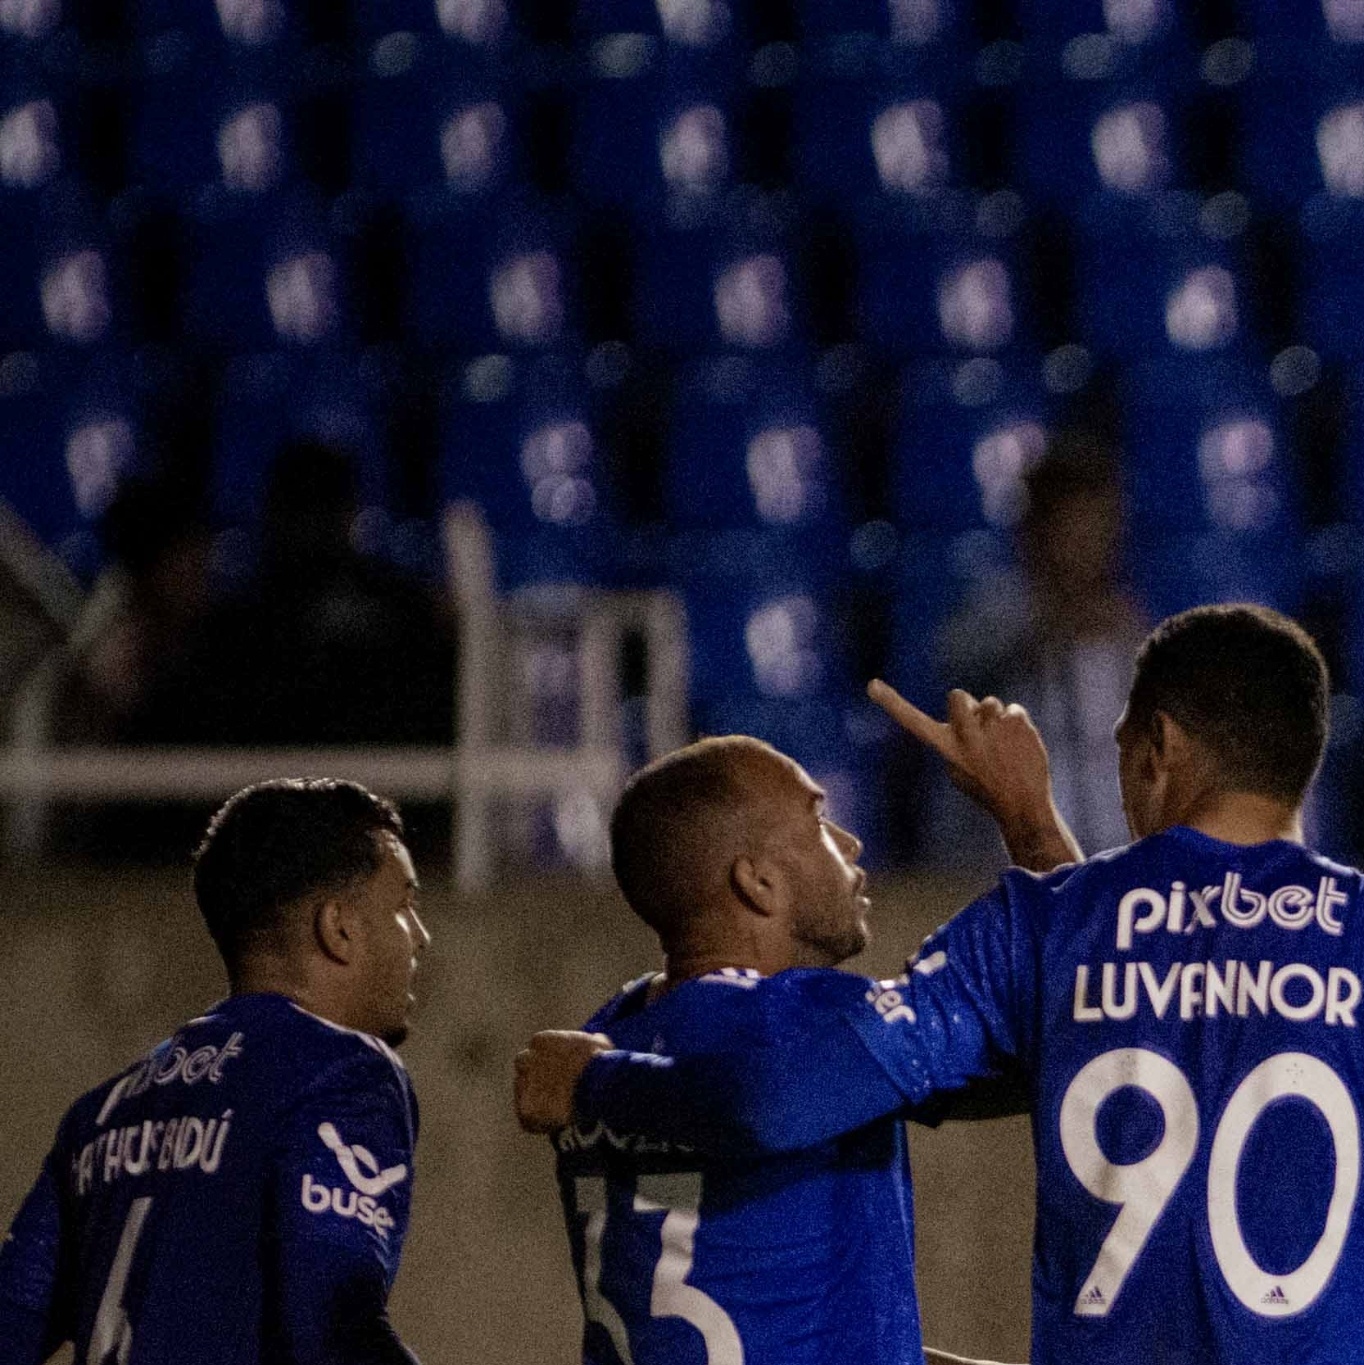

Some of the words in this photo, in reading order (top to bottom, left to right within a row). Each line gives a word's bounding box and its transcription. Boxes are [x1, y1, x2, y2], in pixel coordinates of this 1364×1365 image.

[1117, 872, 1349, 949] pixbet
[1074, 959, 1361, 1027] LUVANNOR
[1060, 1046, 1361, 1317] 90
